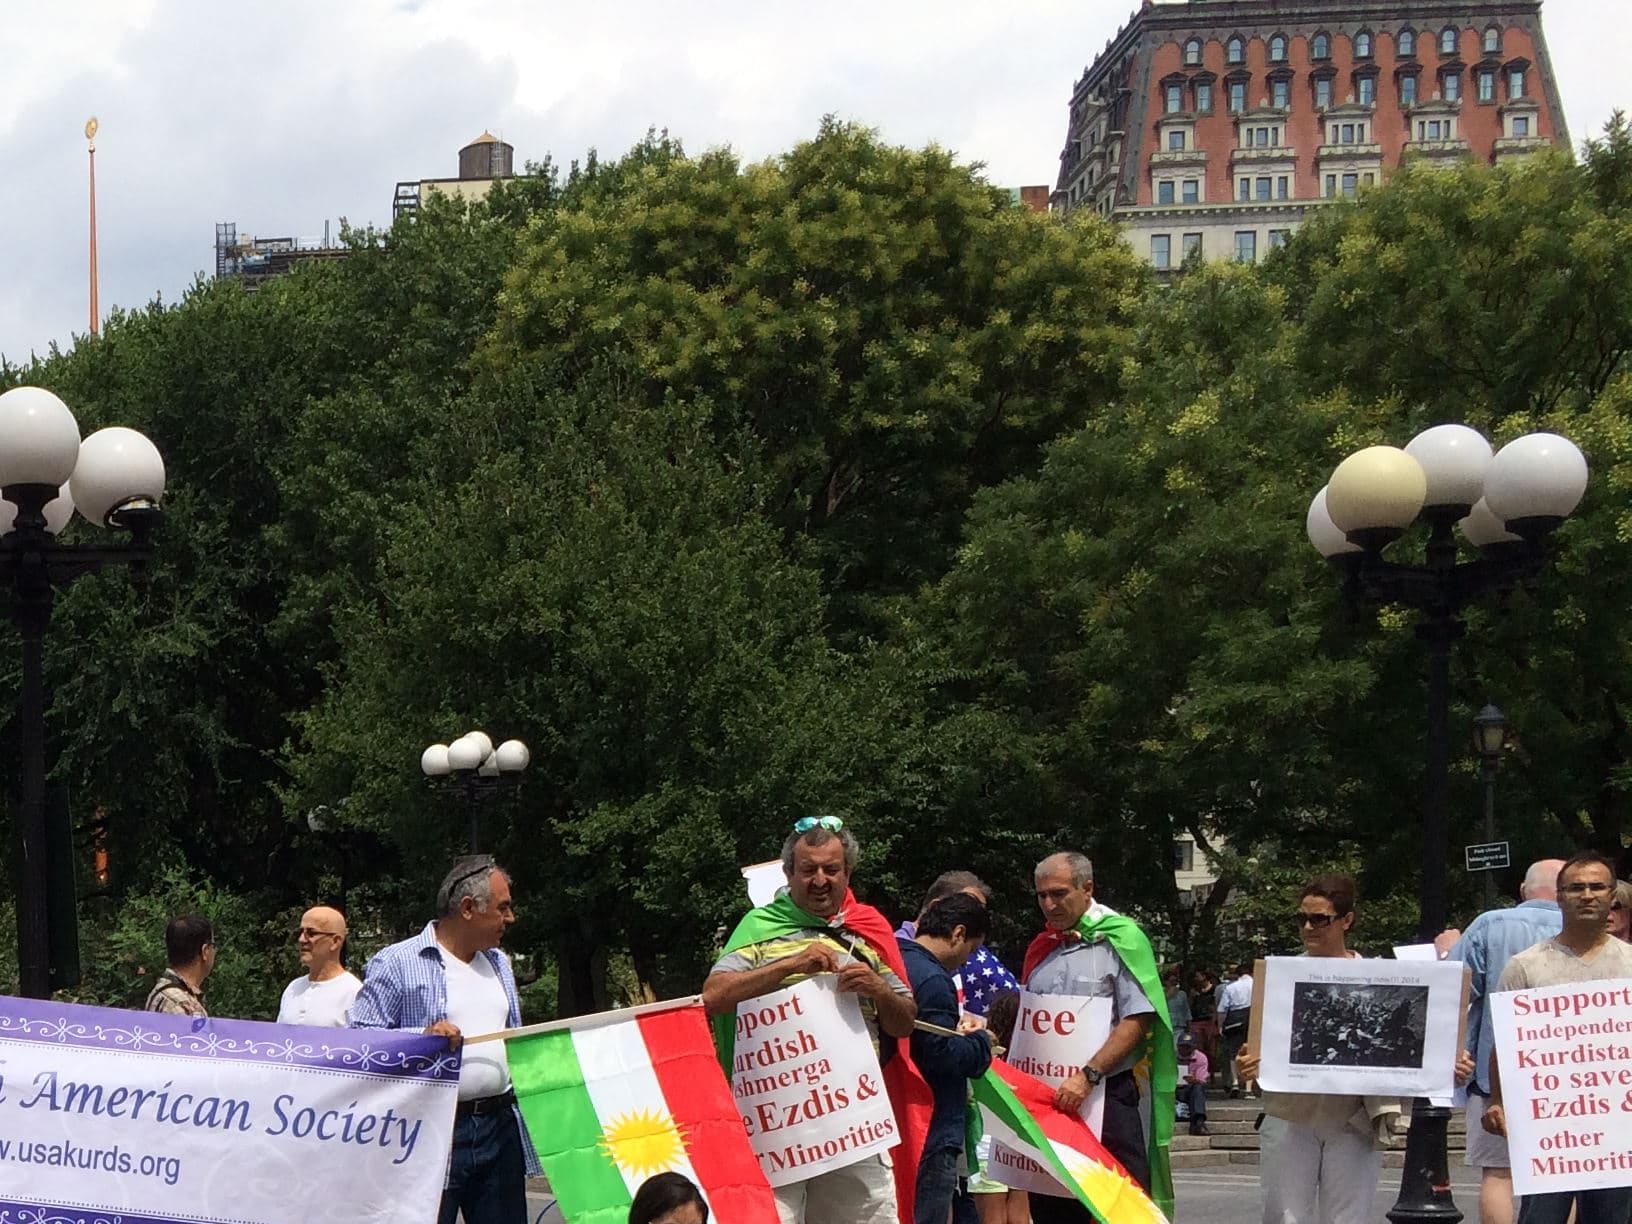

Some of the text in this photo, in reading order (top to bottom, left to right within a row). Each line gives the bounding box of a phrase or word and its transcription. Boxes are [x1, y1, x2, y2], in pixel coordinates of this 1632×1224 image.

[1513, 986, 1632, 1018] Support
[734, 1030, 818, 1075] urdish
[734, 1058, 832, 1099] shmerga
[1532, 1067, 1632, 1092] to save
[18, 1071, 253, 1133] American
[265, 1093, 423, 1165] Society
[755, 1084, 850, 1134] Ezdis
[856, 1072, 879, 1101] &
[1529, 1093, 1611, 1121] Ezdis
[770, 1117, 894, 1174] Minorities
[1539, 1130, 1604, 1151] other
[1532, 1150, 1632, 1177] Minoriti
